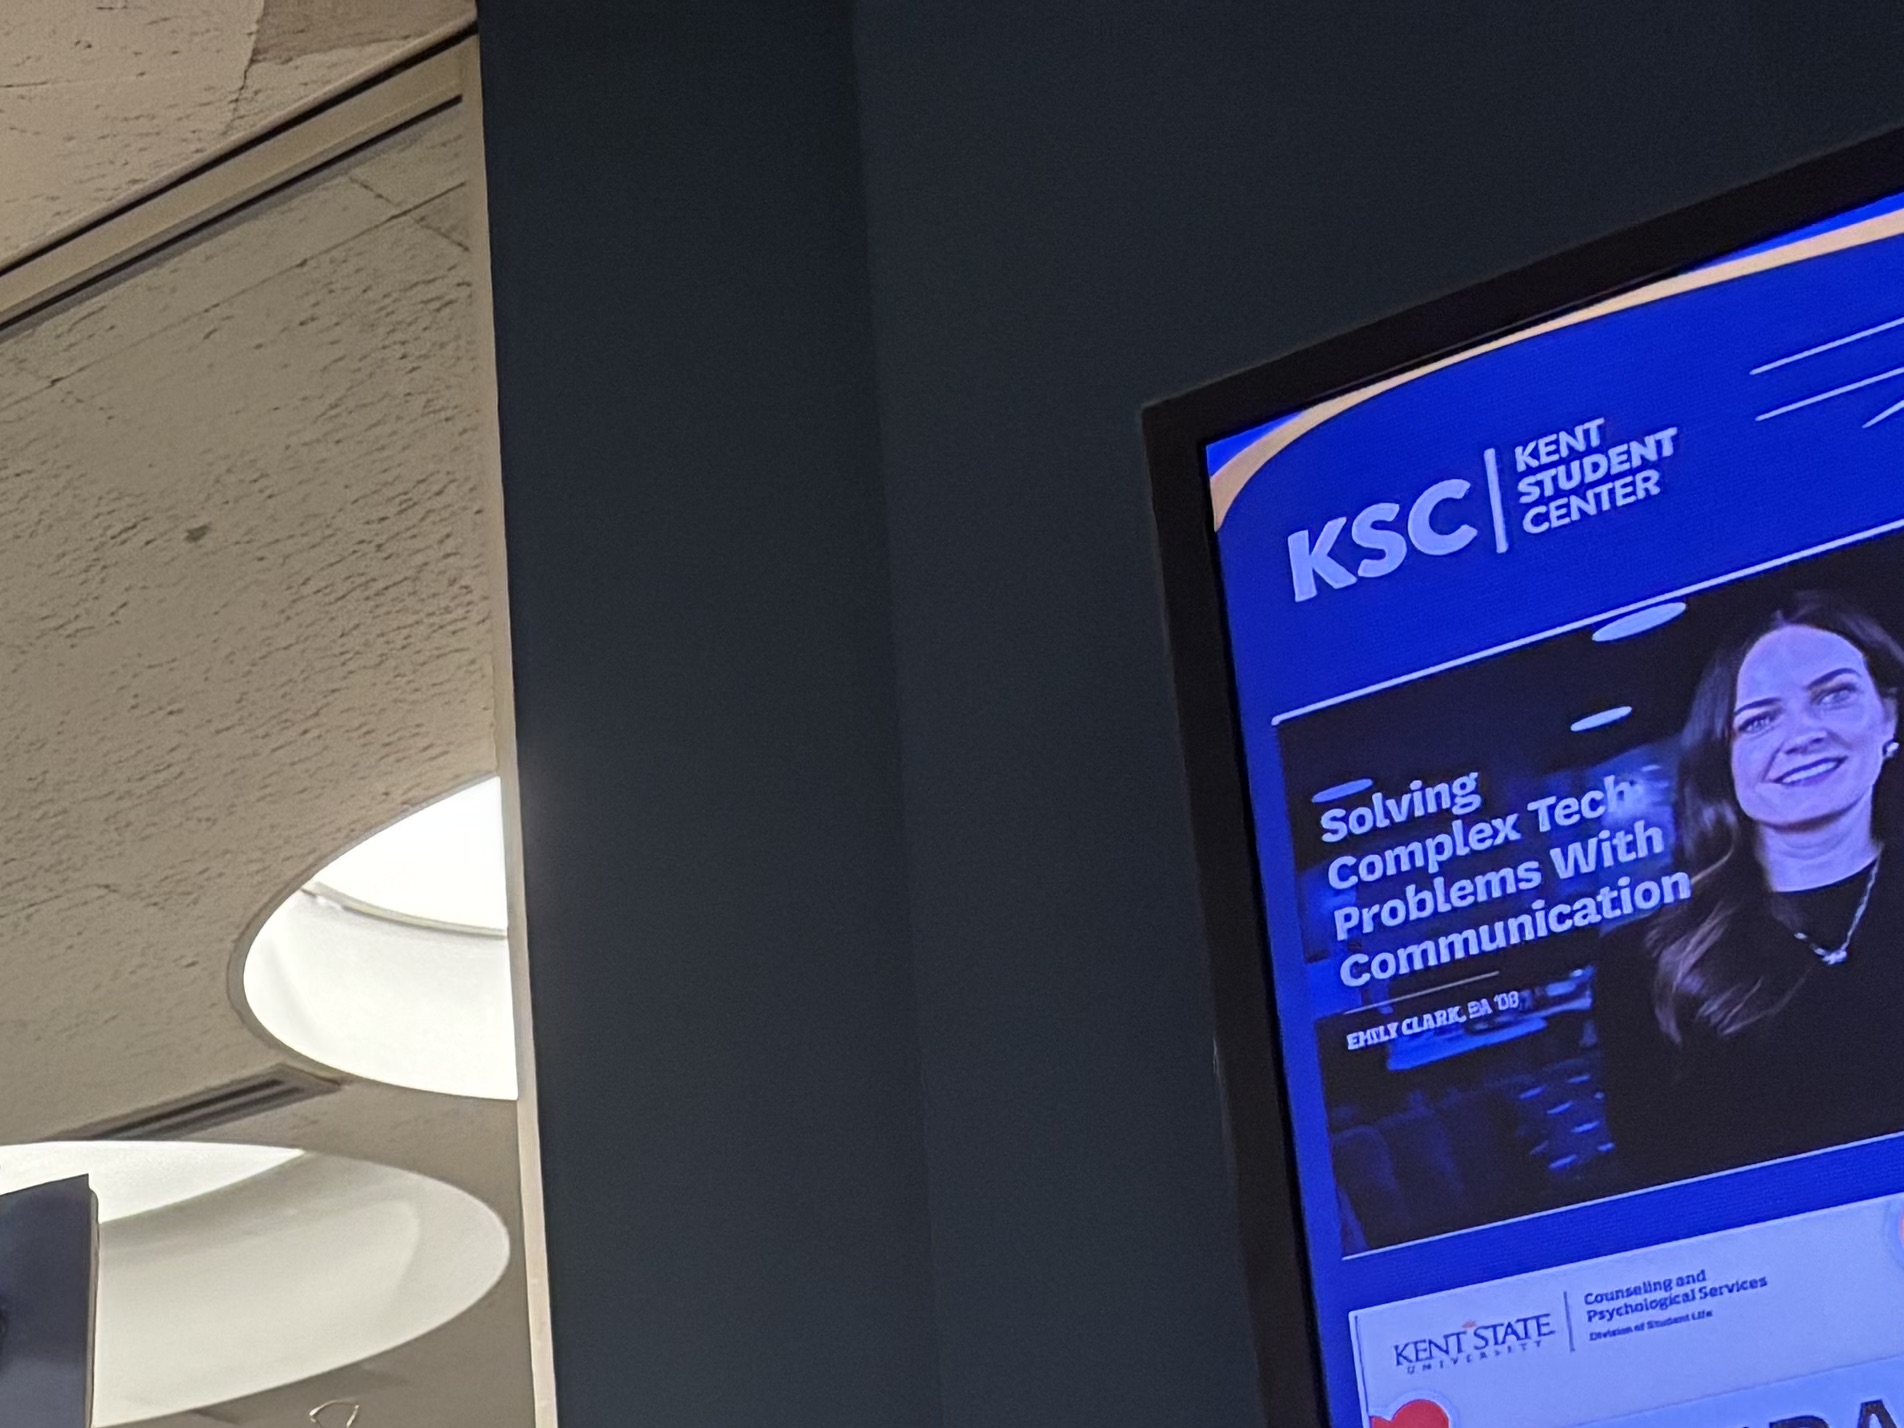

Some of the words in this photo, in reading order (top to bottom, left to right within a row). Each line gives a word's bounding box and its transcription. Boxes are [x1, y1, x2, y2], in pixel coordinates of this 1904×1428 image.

[1513, 417, 1606, 471] KENT
[1516, 426, 1678, 504] STUDENT
[1521, 469, 1662, 536] CENTER
[1285, 478, 1477, 601] KSC
[1319, 768, 1481, 844] Solving
[1327, 815, 1521, 893] Complex
[1526, 776, 1636, 846] Tech
[1333, 853, 1542, 942] Problems
[1548, 822, 1663, 884] With
[1339, 867, 1691, 988] Communication
[1347, 1022, 1398, 1050] EMILY
[1401, 1006, 1467, 1035] CLARK,
[1584, 1277, 1673, 1305] Counseling
[1676, 1270, 1706, 1289] and
[1586, 1287, 1695, 1322] Psychological
[1698, 1275, 1768, 1299] Services
[1394, 1331, 1466, 1367] KENT
[1473, 1313, 1555, 1351] STATE
[1589, 1326, 1632, 1341] Division
[1634, 1323, 1645, 1332] of
[1647, 1313, 1691, 1329] Student
[1692, 1310, 1713, 1320] Life
[1407, 1341, 1543, 1374] UNIVERSITY
